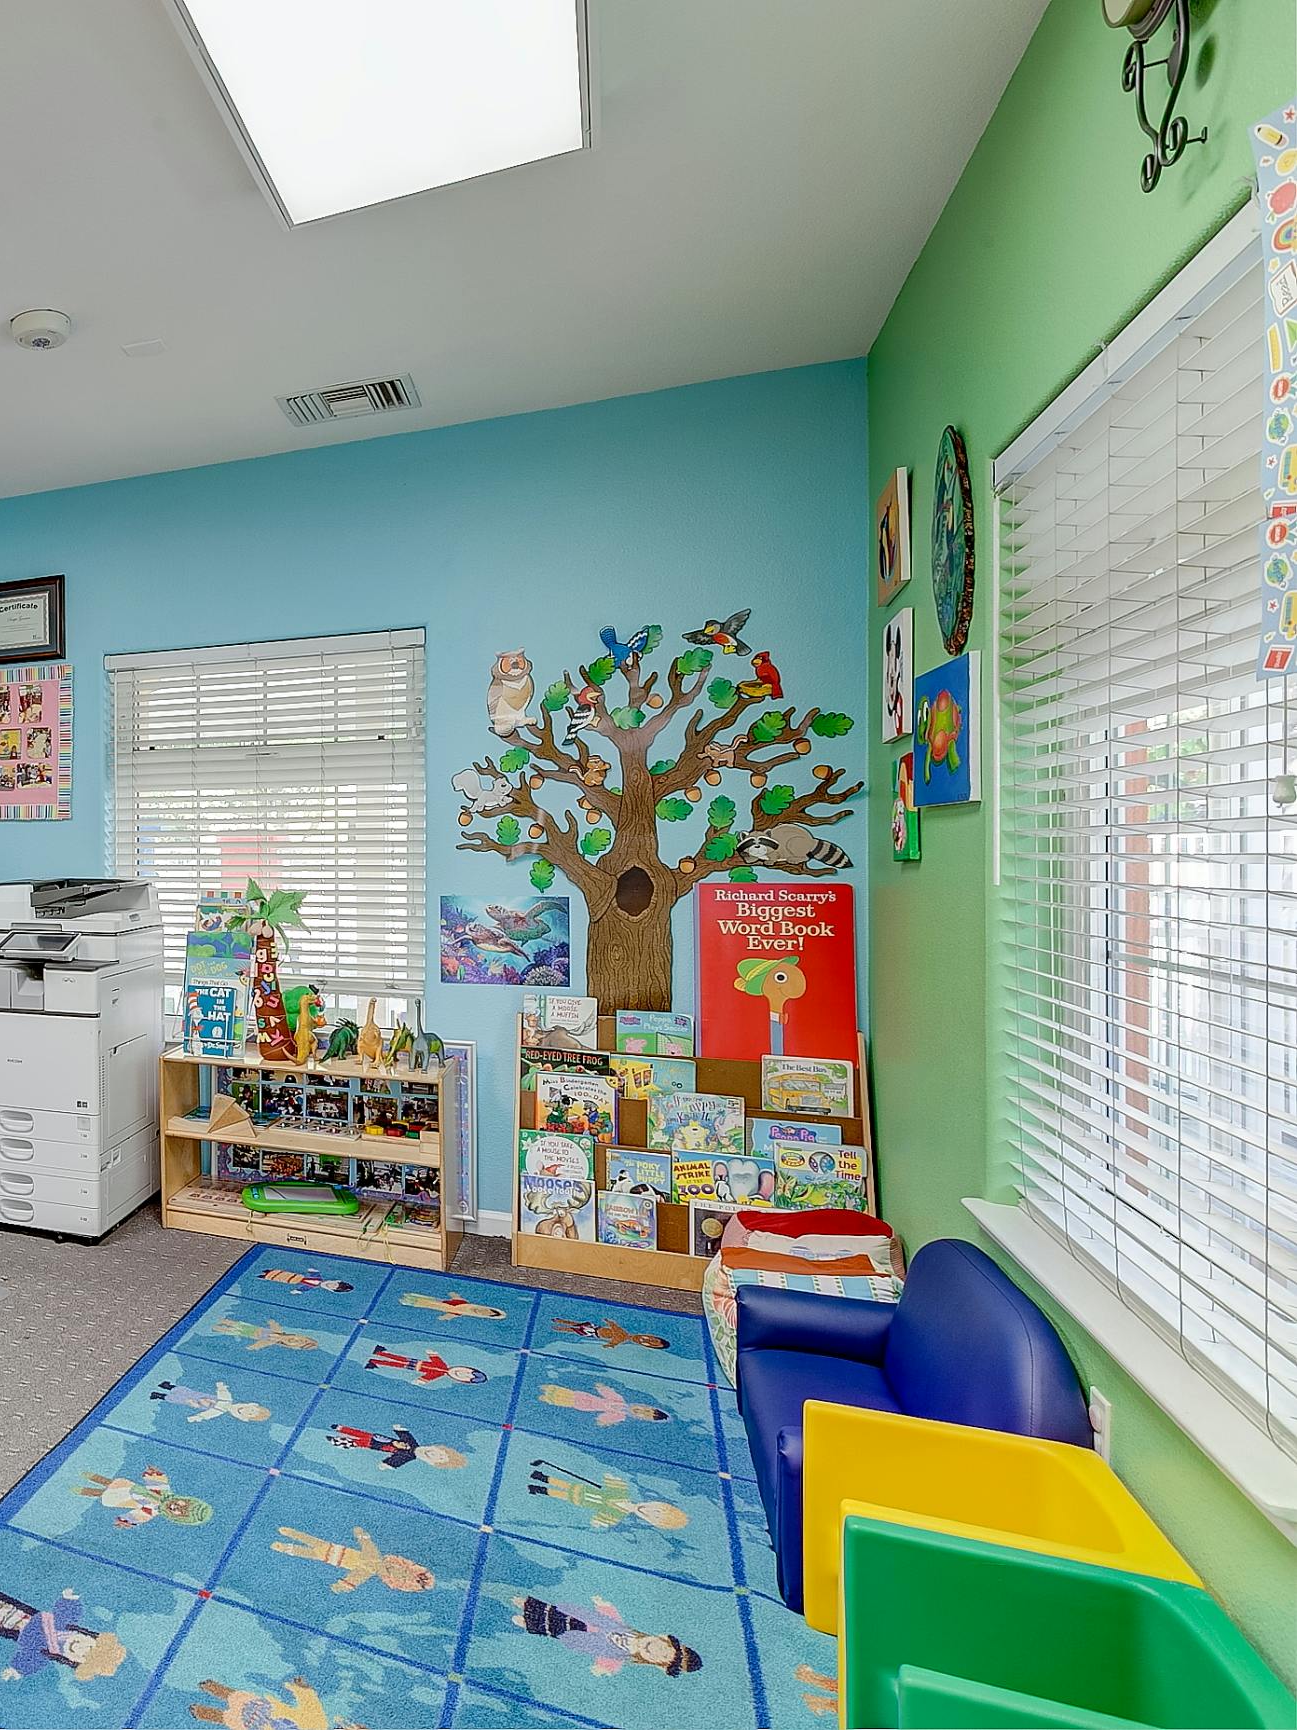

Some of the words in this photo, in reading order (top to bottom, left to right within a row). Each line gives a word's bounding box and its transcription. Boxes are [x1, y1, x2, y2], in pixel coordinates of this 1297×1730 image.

[714, 889, 775, 901] Richard
[778, 889, 837, 904] Scarry's
[736, 902, 816, 921] Biggest
[717, 919, 775, 936] Word
[779, 921, 835, 937] Book
[746, 935, 805, 951] Ever!
[195, 988, 210, 996] THE
[209, 987, 232, 998] CAT
[212, 1004, 227, 1012] THE
[207, 1010, 232, 1021] HAT
[525, 1049, 563, 1063] RED-EYED
[562, 1052, 582, 1064] TREE
[582, 1055, 604, 1066] FROG
[782, 1063, 796, 1072] The
[796, 1065, 812, 1073] Best
[812, 1065, 828, 1074] Bus
[563, 1083, 597, 1093] Celebrates
[556, 1156, 580, 1164] MOVIES
[838, 1149, 857, 1160] Tell
[636, 1161, 661, 1169] POKY
[674, 1162, 711, 1172] ANIMAL
[838, 1161, 858, 1170] the
[637, 1169, 666, 1177] LITTLE
[676, 1170, 711, 1180] STRIKE
[835, 1170, 862, 1181] Time
[678, 1183, 715, 1197] ZOO
